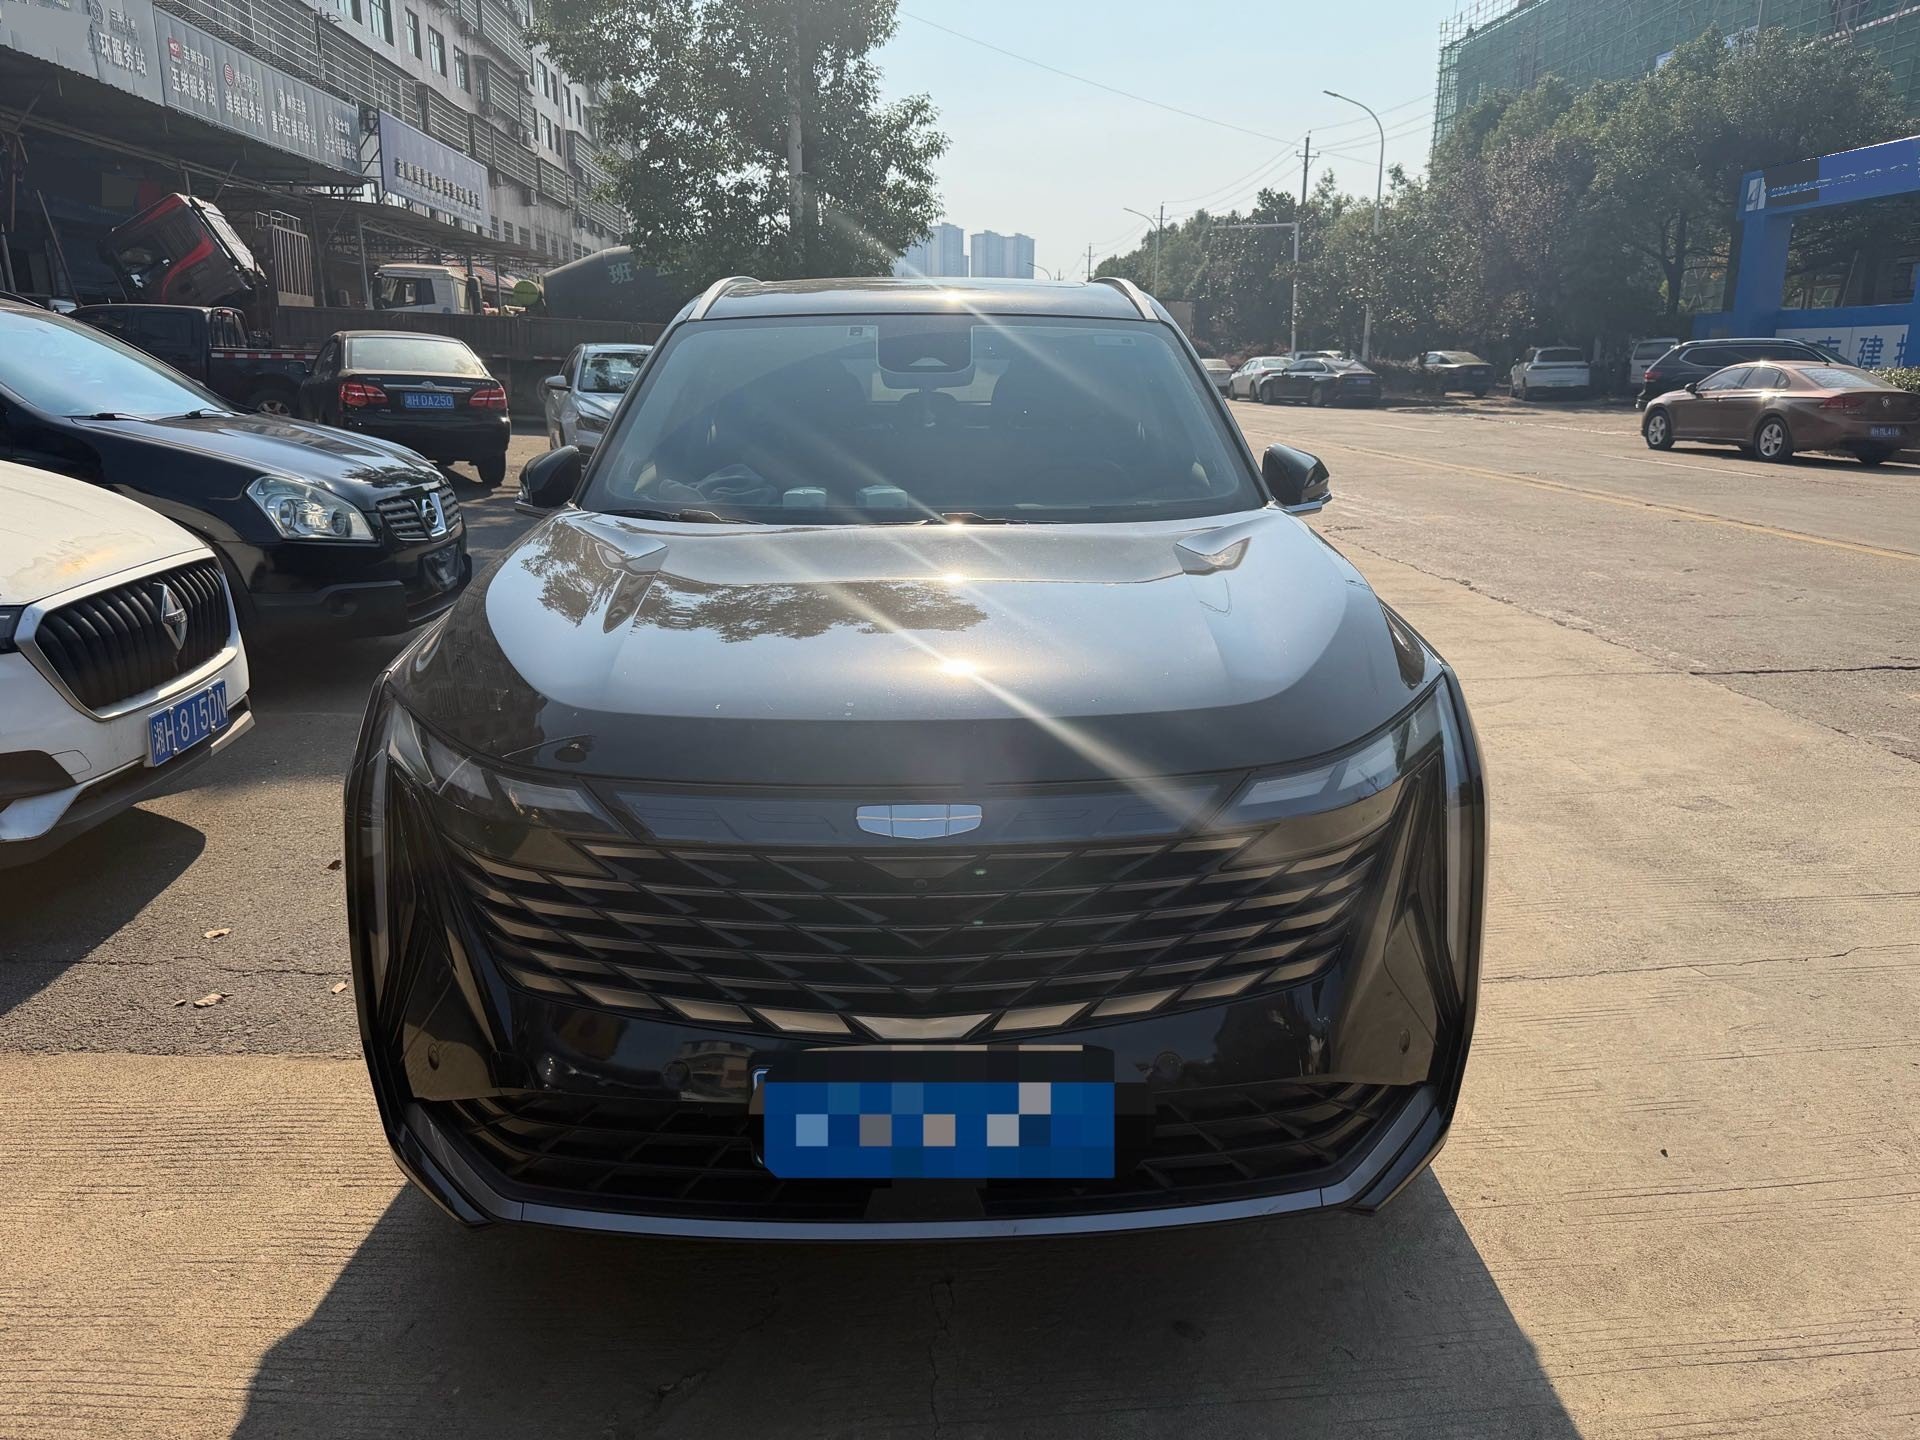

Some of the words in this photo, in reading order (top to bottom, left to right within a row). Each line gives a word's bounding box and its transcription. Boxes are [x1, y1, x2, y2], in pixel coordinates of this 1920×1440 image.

[99, 32, 147, 76] 环服务站
[170, 66, 216, 108] 玉柴服务站
[225, 89, 264, 126] 潍柴服务站
[608, 262, 635, 284] 班
